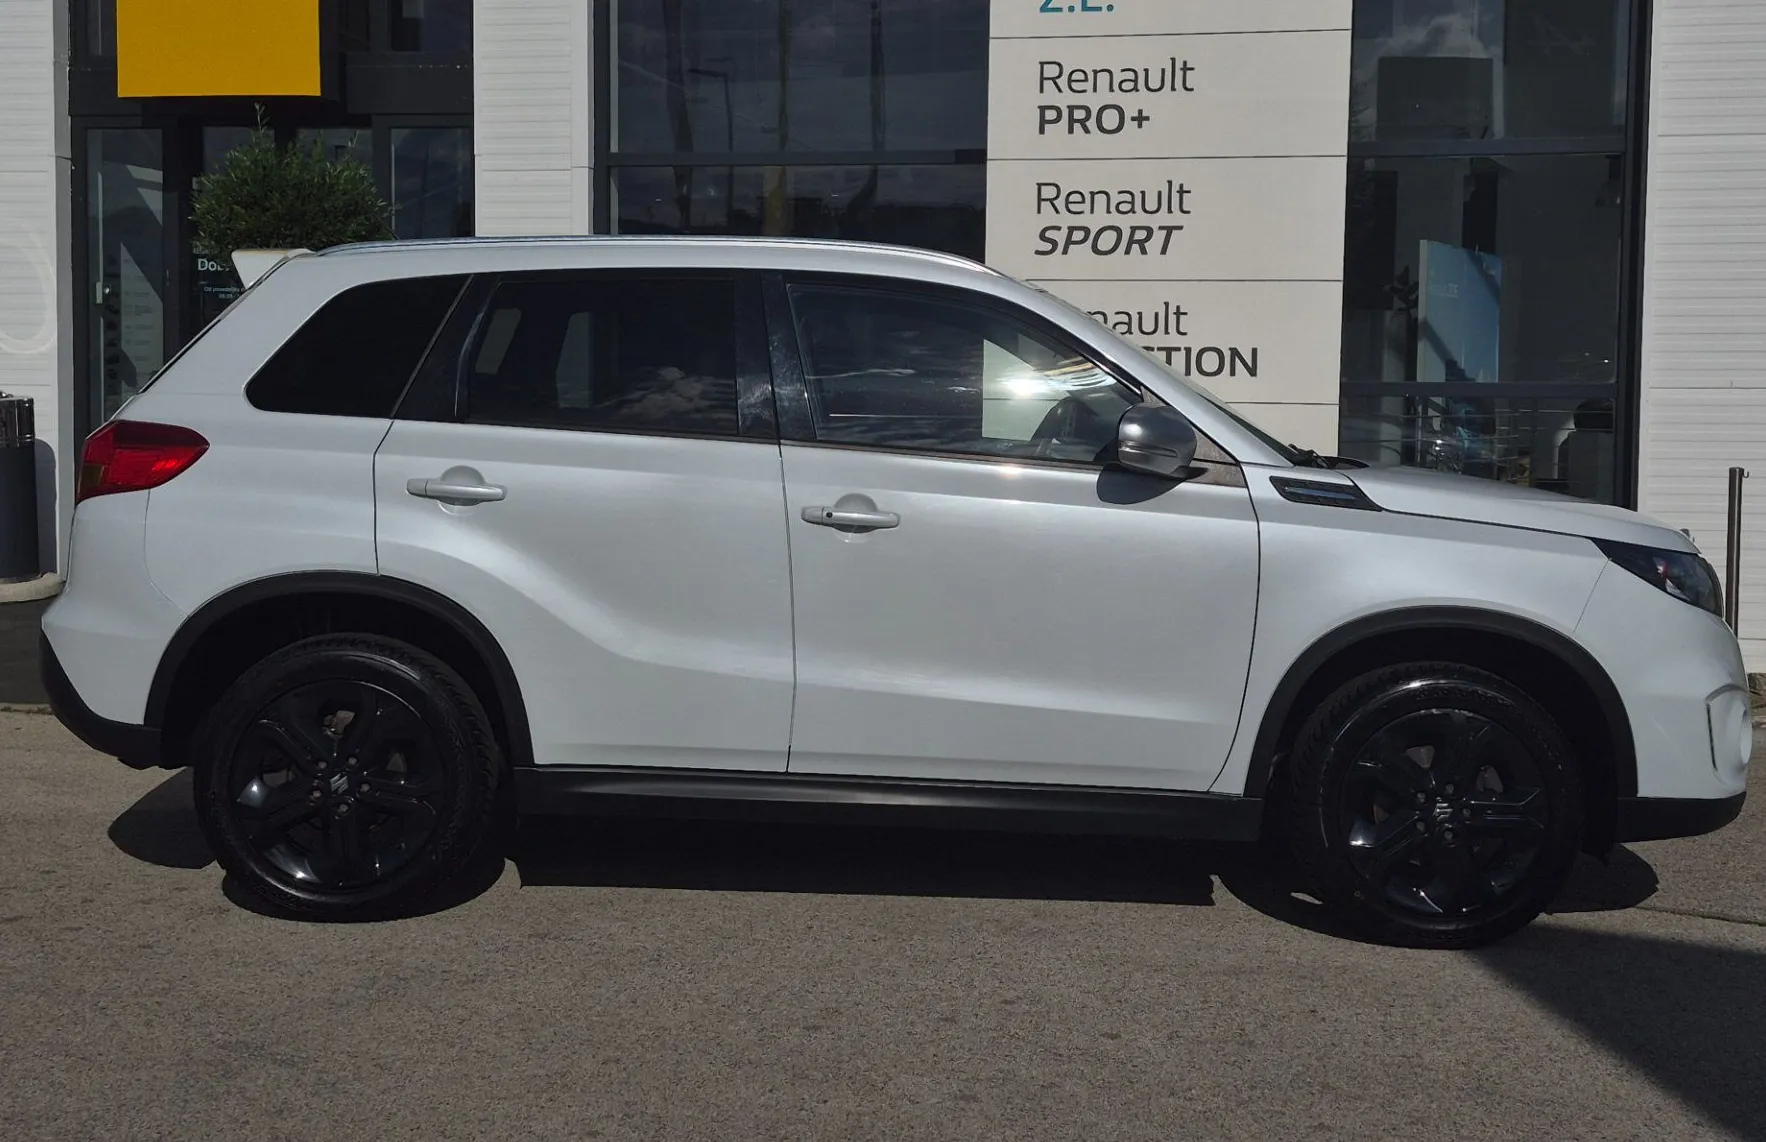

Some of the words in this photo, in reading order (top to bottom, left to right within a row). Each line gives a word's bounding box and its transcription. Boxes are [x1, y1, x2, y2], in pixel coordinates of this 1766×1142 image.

[1038, 57, 1195, 94] Renault
[1037, 104, 1150, 135] PRO+
[1035, 180, 1192, 215] Renault
[1034, 225, 1184, 256] SPORT
[1141, 346, 1258, 377] TION
